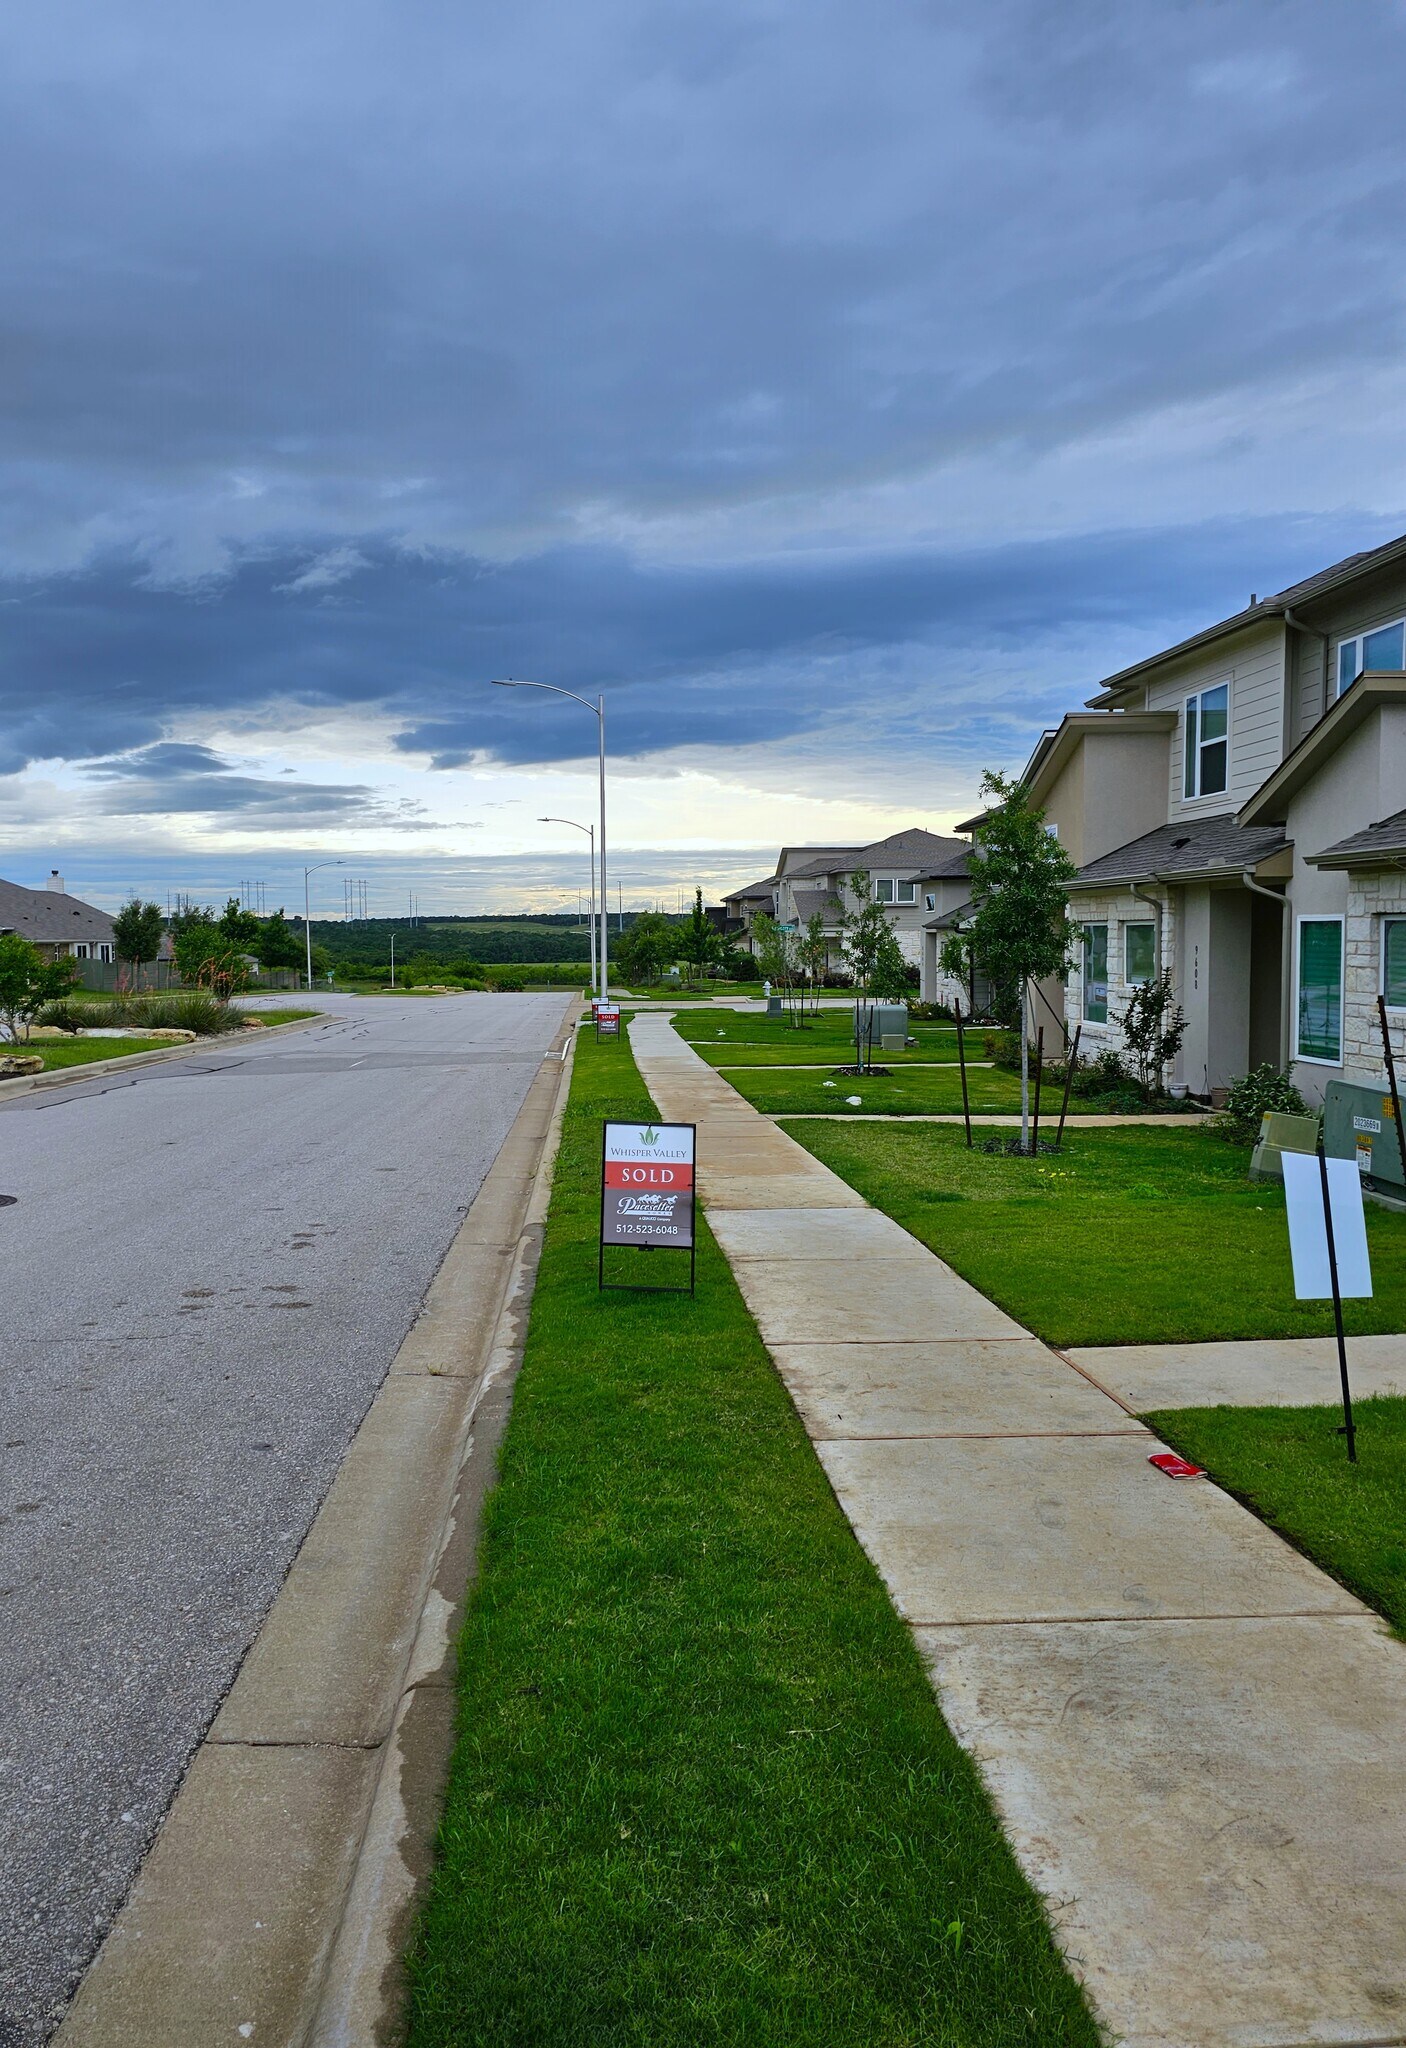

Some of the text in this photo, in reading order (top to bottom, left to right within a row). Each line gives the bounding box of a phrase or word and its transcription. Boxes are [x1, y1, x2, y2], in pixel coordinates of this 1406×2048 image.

[610, 1147, 687, 1158] WHISPER VALLEY
[622, 1168, 674, 1183] SOLD
[616, 1224, 678, 1235] 512-523-6048
